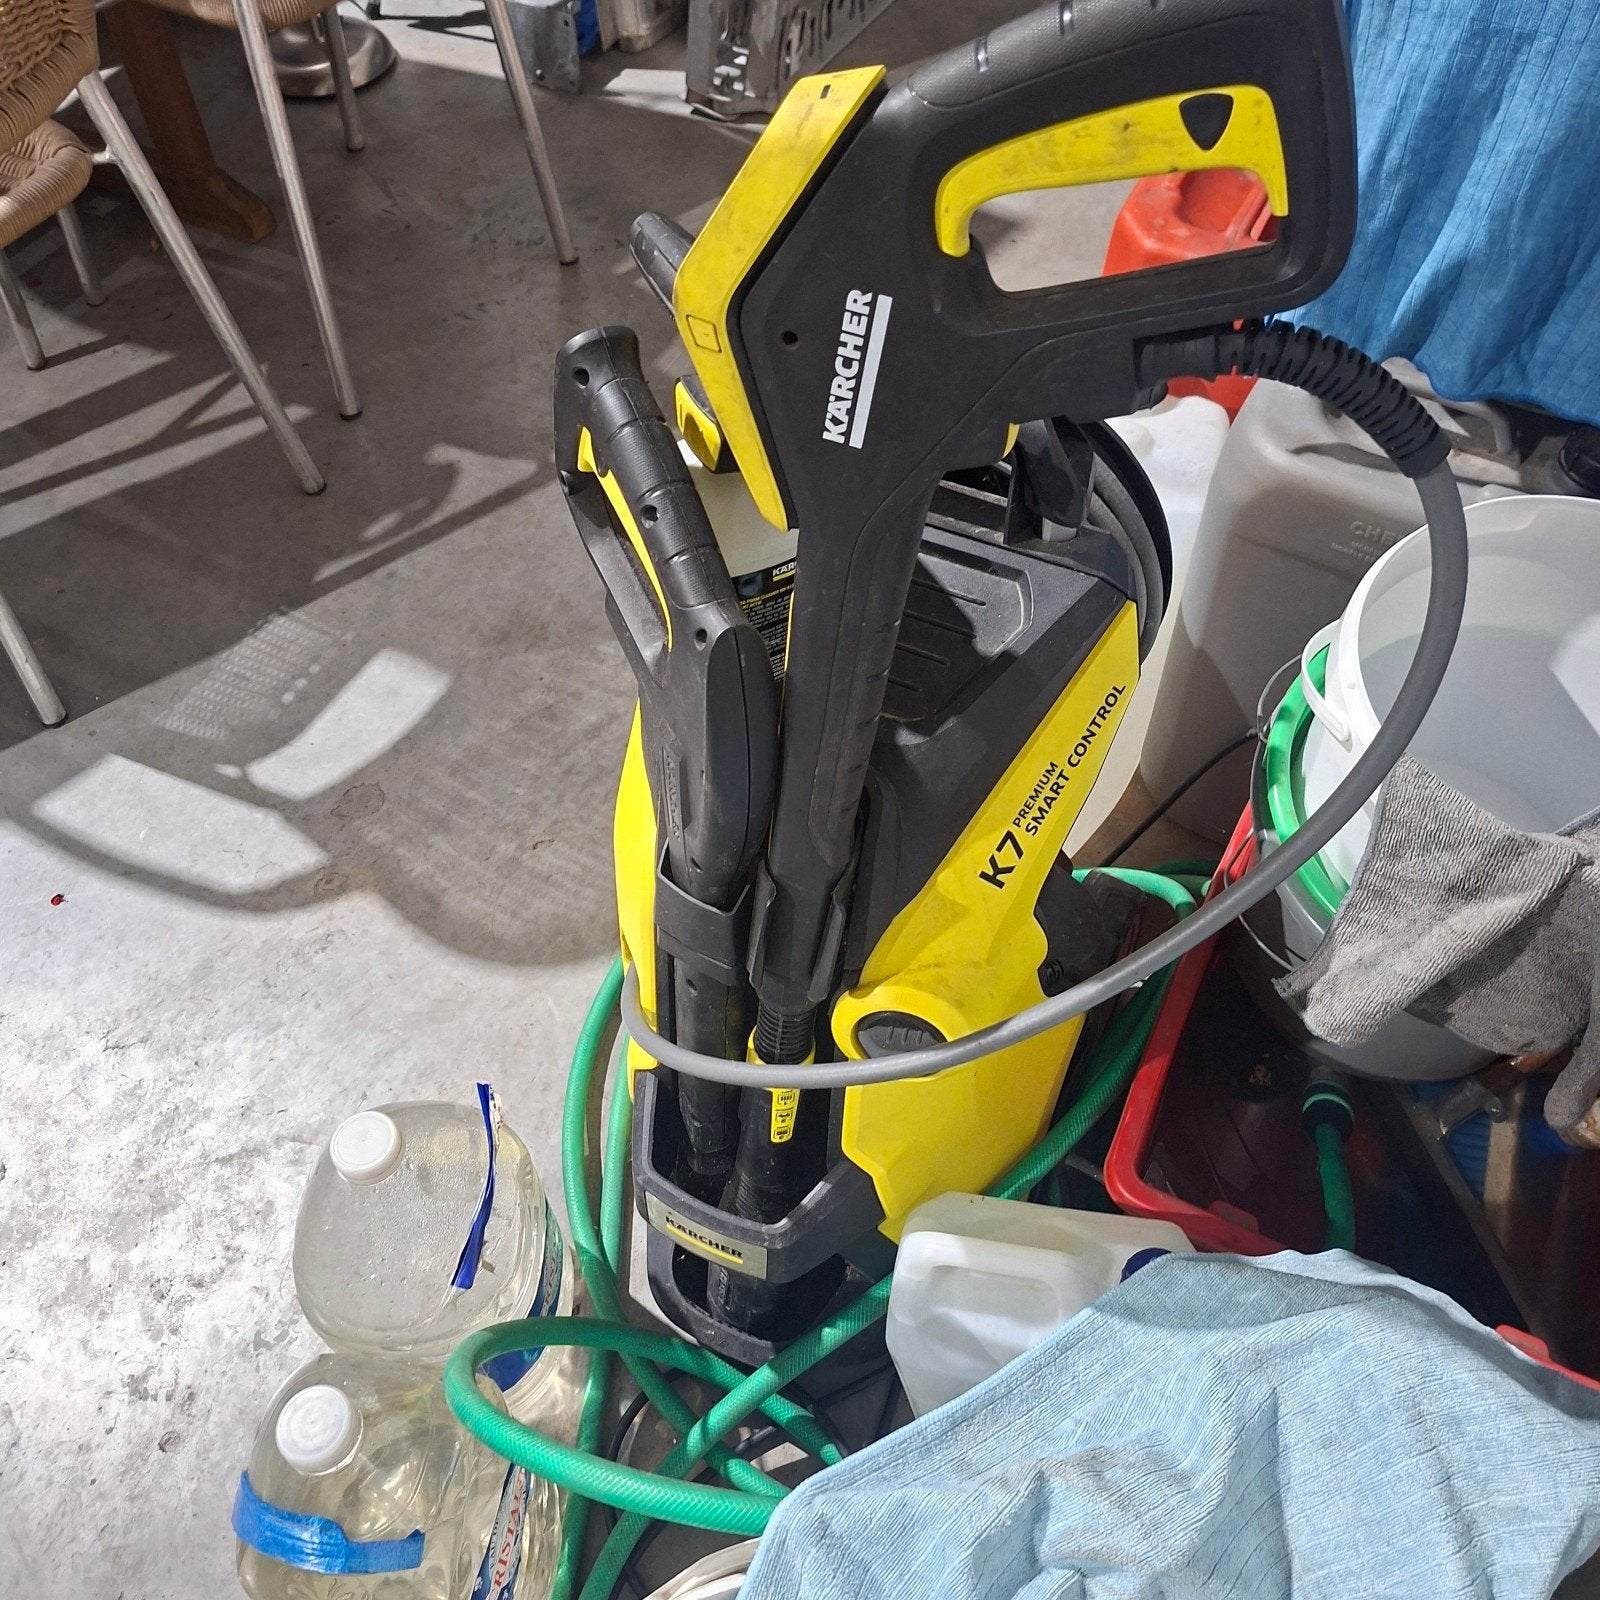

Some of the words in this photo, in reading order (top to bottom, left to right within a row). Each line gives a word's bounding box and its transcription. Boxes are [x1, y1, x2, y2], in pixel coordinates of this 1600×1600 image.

[822, 289, 873, 444] KÄRCHER
[1349, 520, 1399, 545] CHE
[1025, 768, 1070, 836] SMART
[1067, 685, 1127, 768] CONTROL
[1012, 761, 1059, 828] PREMIUM
[978, 829, 1024, 889] K7
